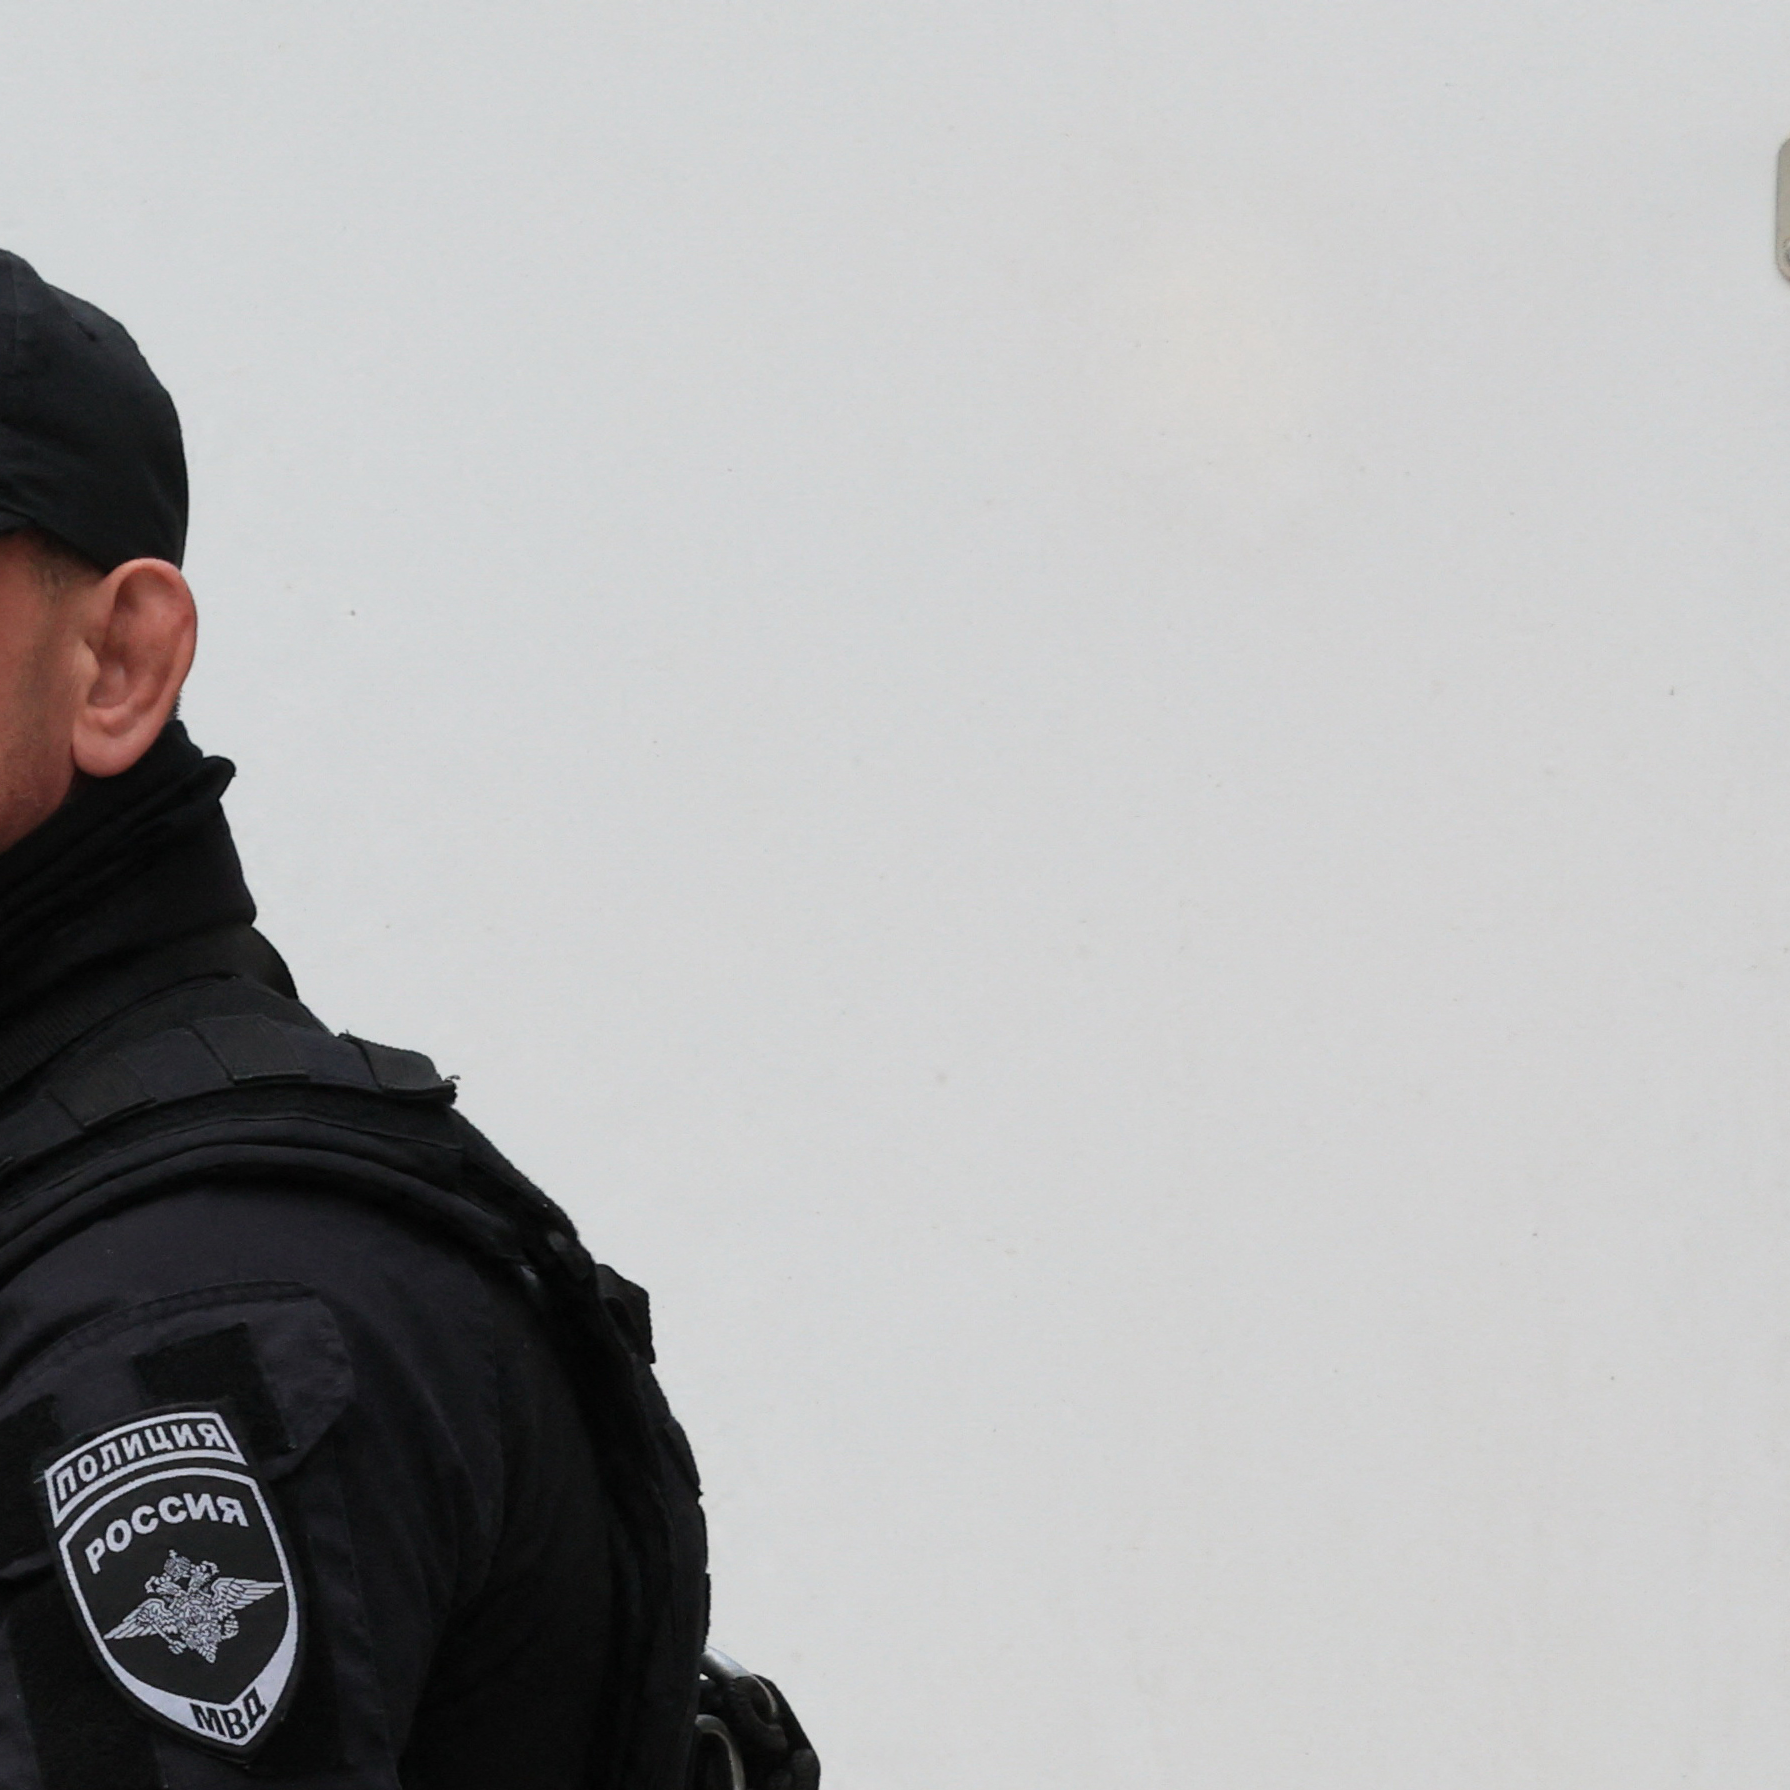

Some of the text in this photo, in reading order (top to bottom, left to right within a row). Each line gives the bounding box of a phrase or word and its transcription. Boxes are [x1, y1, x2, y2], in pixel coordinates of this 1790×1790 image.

[55, 1420, 227, 1500] ПОЛИЦИЯ
[85, 1492, 249, 1574] РОССИЯ
[189, 1686, 267, 1740] МВД
